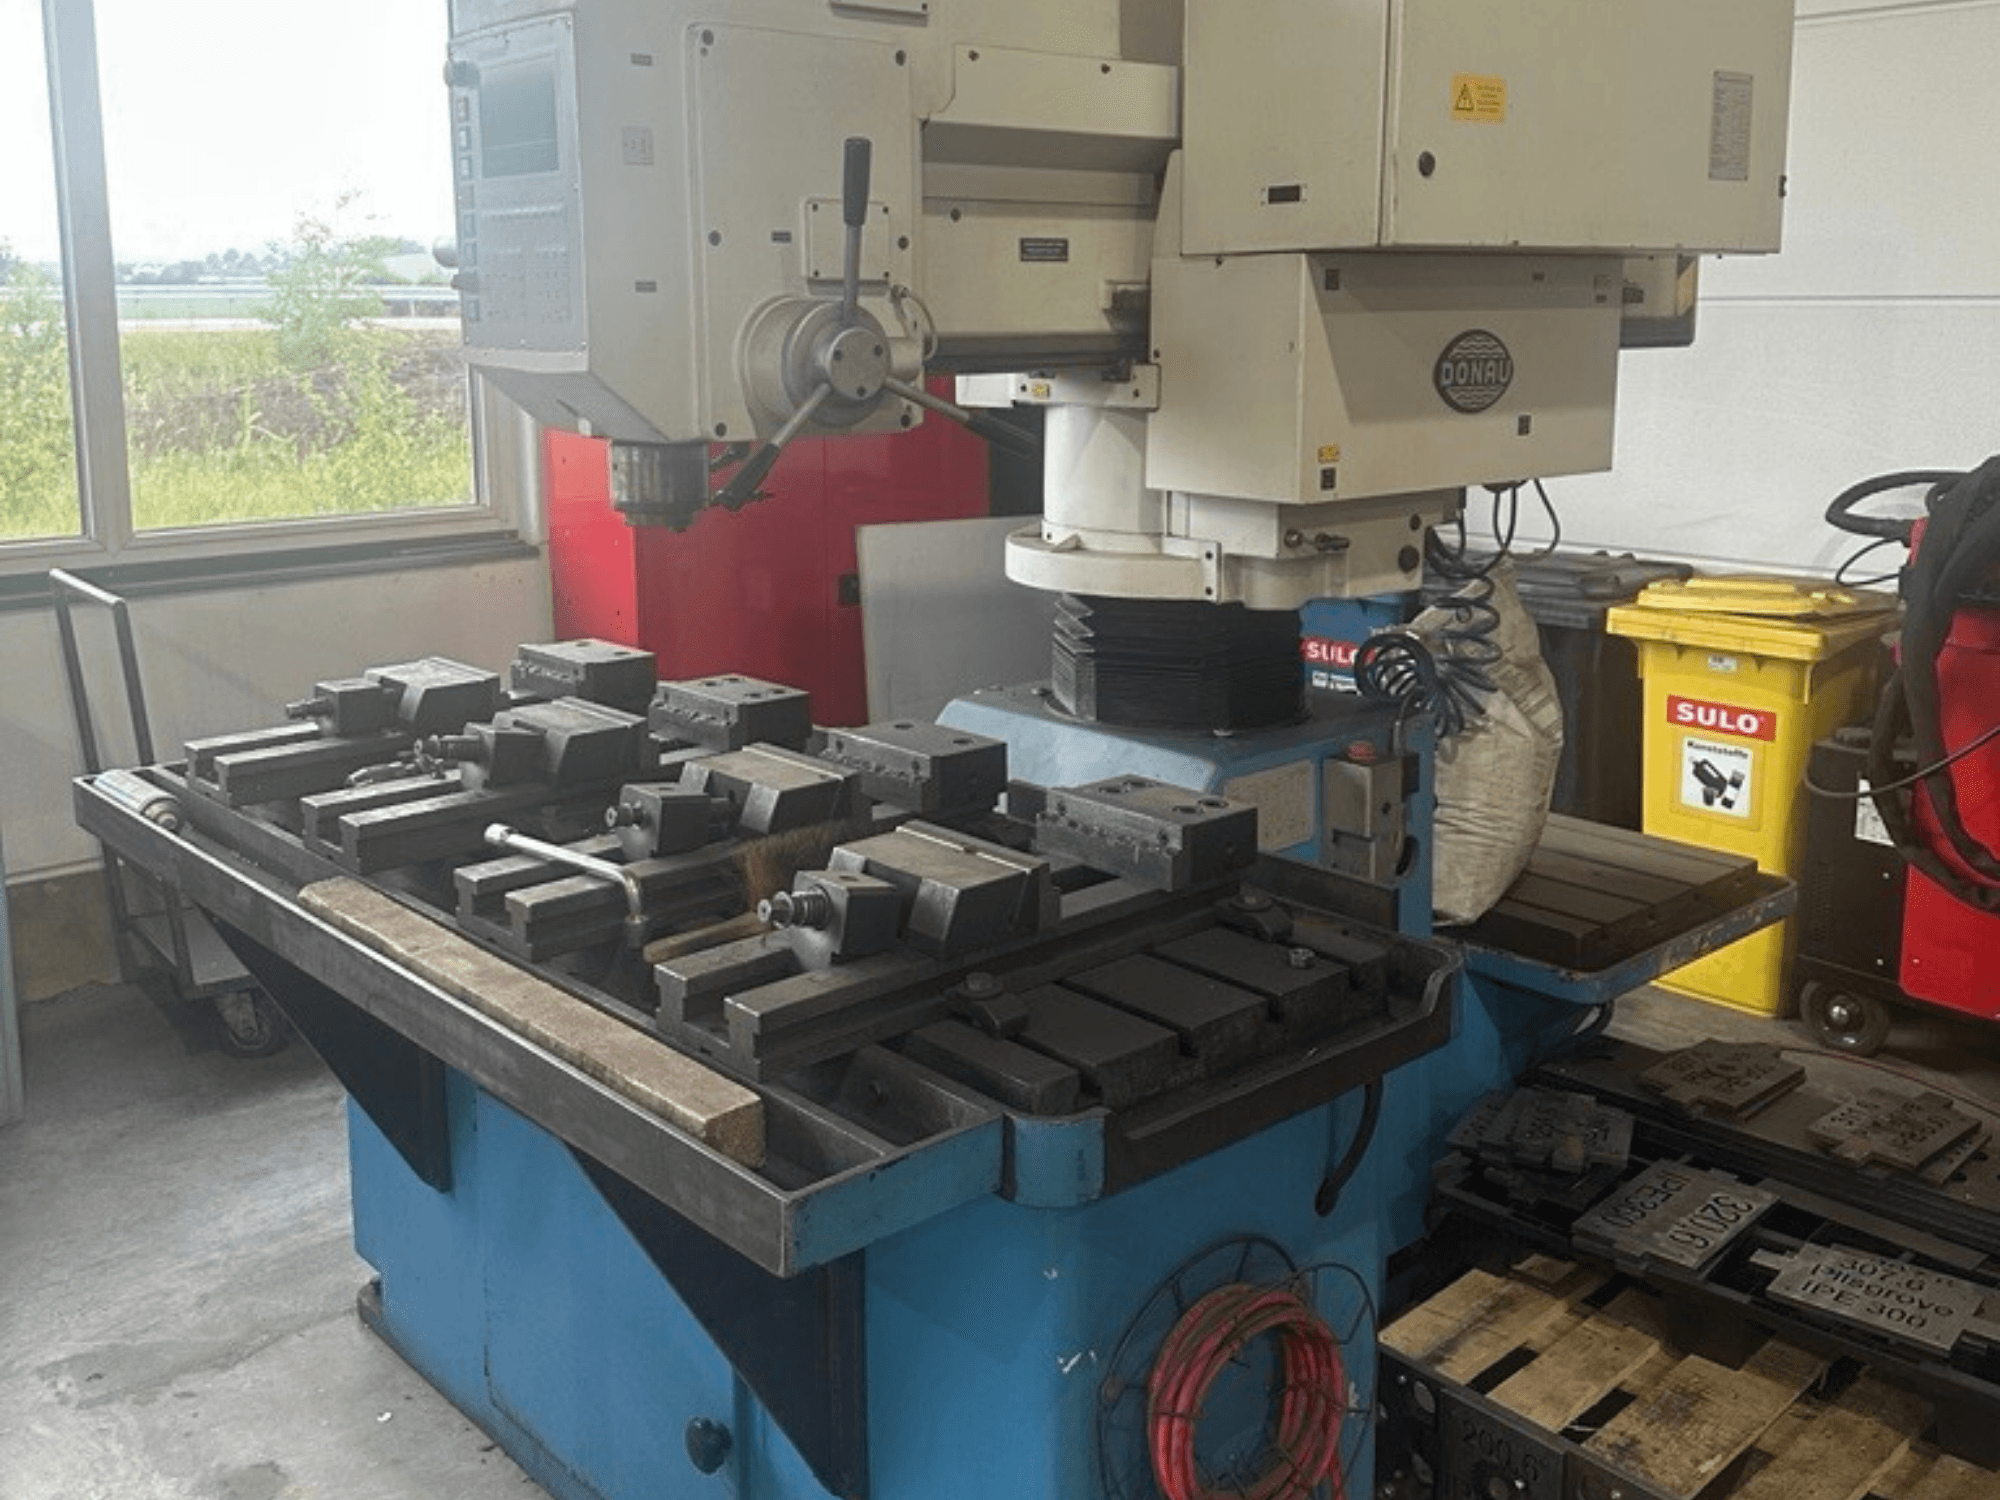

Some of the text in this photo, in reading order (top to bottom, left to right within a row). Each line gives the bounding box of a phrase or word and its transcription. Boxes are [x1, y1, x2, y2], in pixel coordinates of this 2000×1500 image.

[1442, 360, 1512, 385] DONAU
[1676, 702, 1760, 734] SULO
[1802, 1280, 1928, 1329] IPE 300
